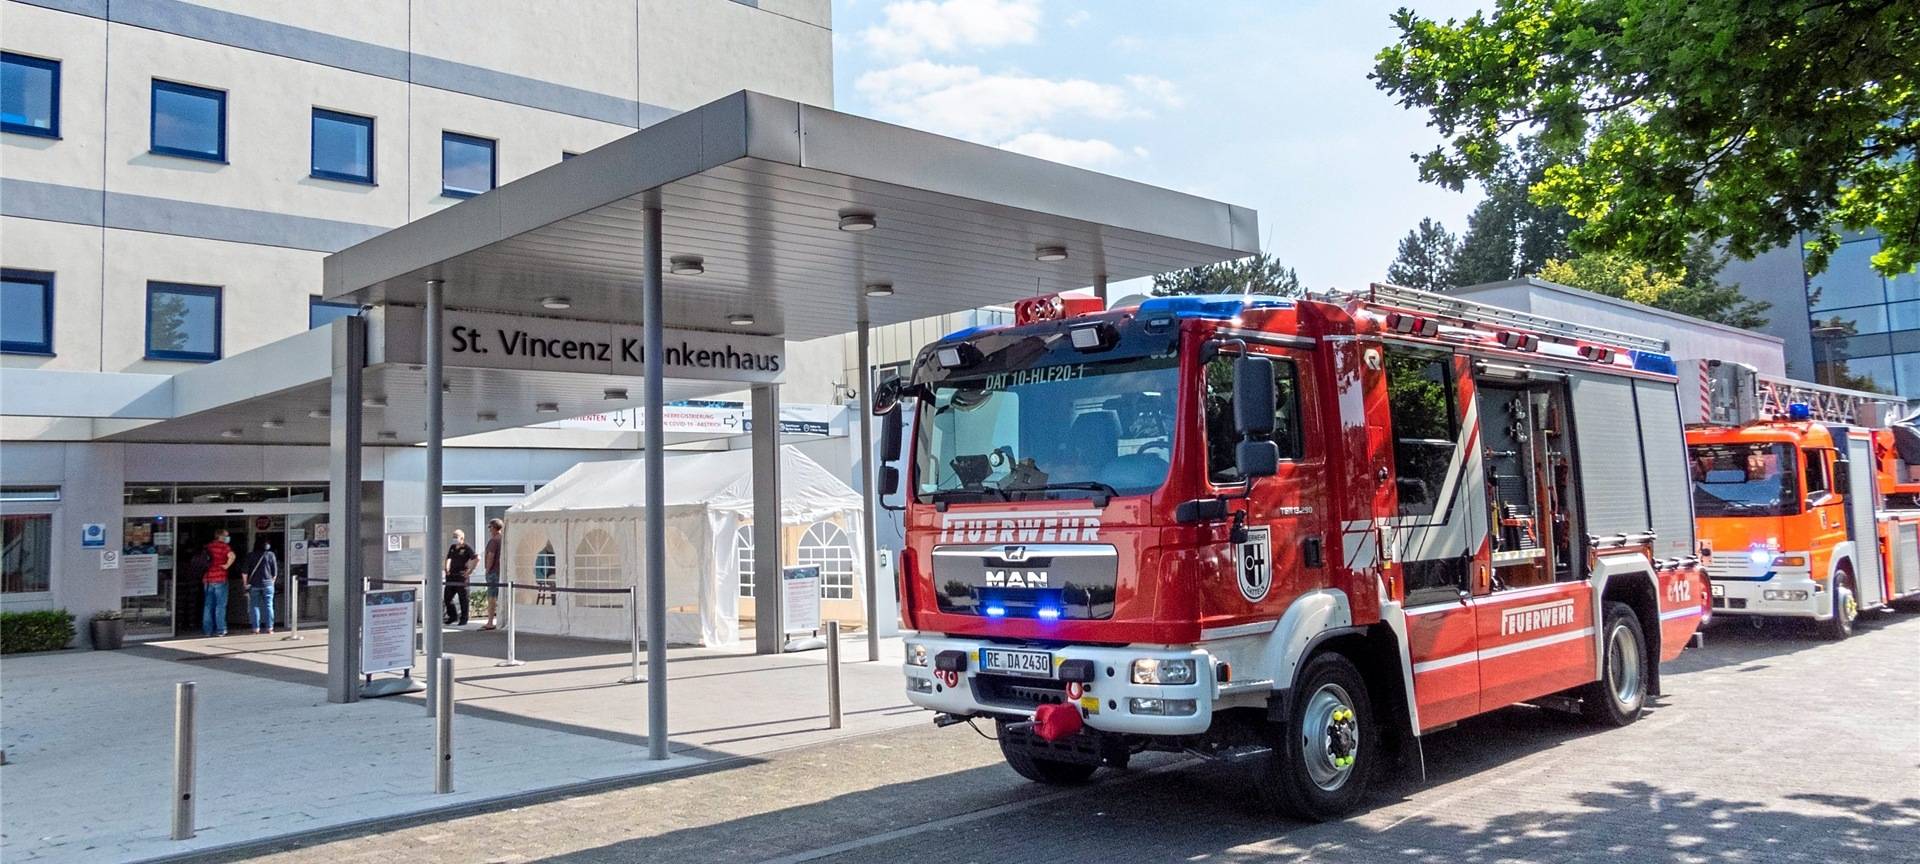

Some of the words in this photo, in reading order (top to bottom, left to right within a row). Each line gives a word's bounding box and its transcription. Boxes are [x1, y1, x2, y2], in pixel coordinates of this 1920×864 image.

[452, 325, 488, 353] St.
[498, 329, 611, 362] Vincenz
[621, 337, 780, 372] Knkenhaus
[985, 373, 1008, 390] DAT
[1012, 364, 1085, 386] 10-HLF20-1
[940, 509, 1103, 543] FEUERWEHR
[986, 570, 1048, 588] MAN
[1673, 580, 1690, 602] 112
[1501, 598, 1575, 636] FEUERWEHR
[987, 652, 1000, 668] RE
[1007, 653, 1020, 669] DA
[1022, 654, 1048, 671] 2430
